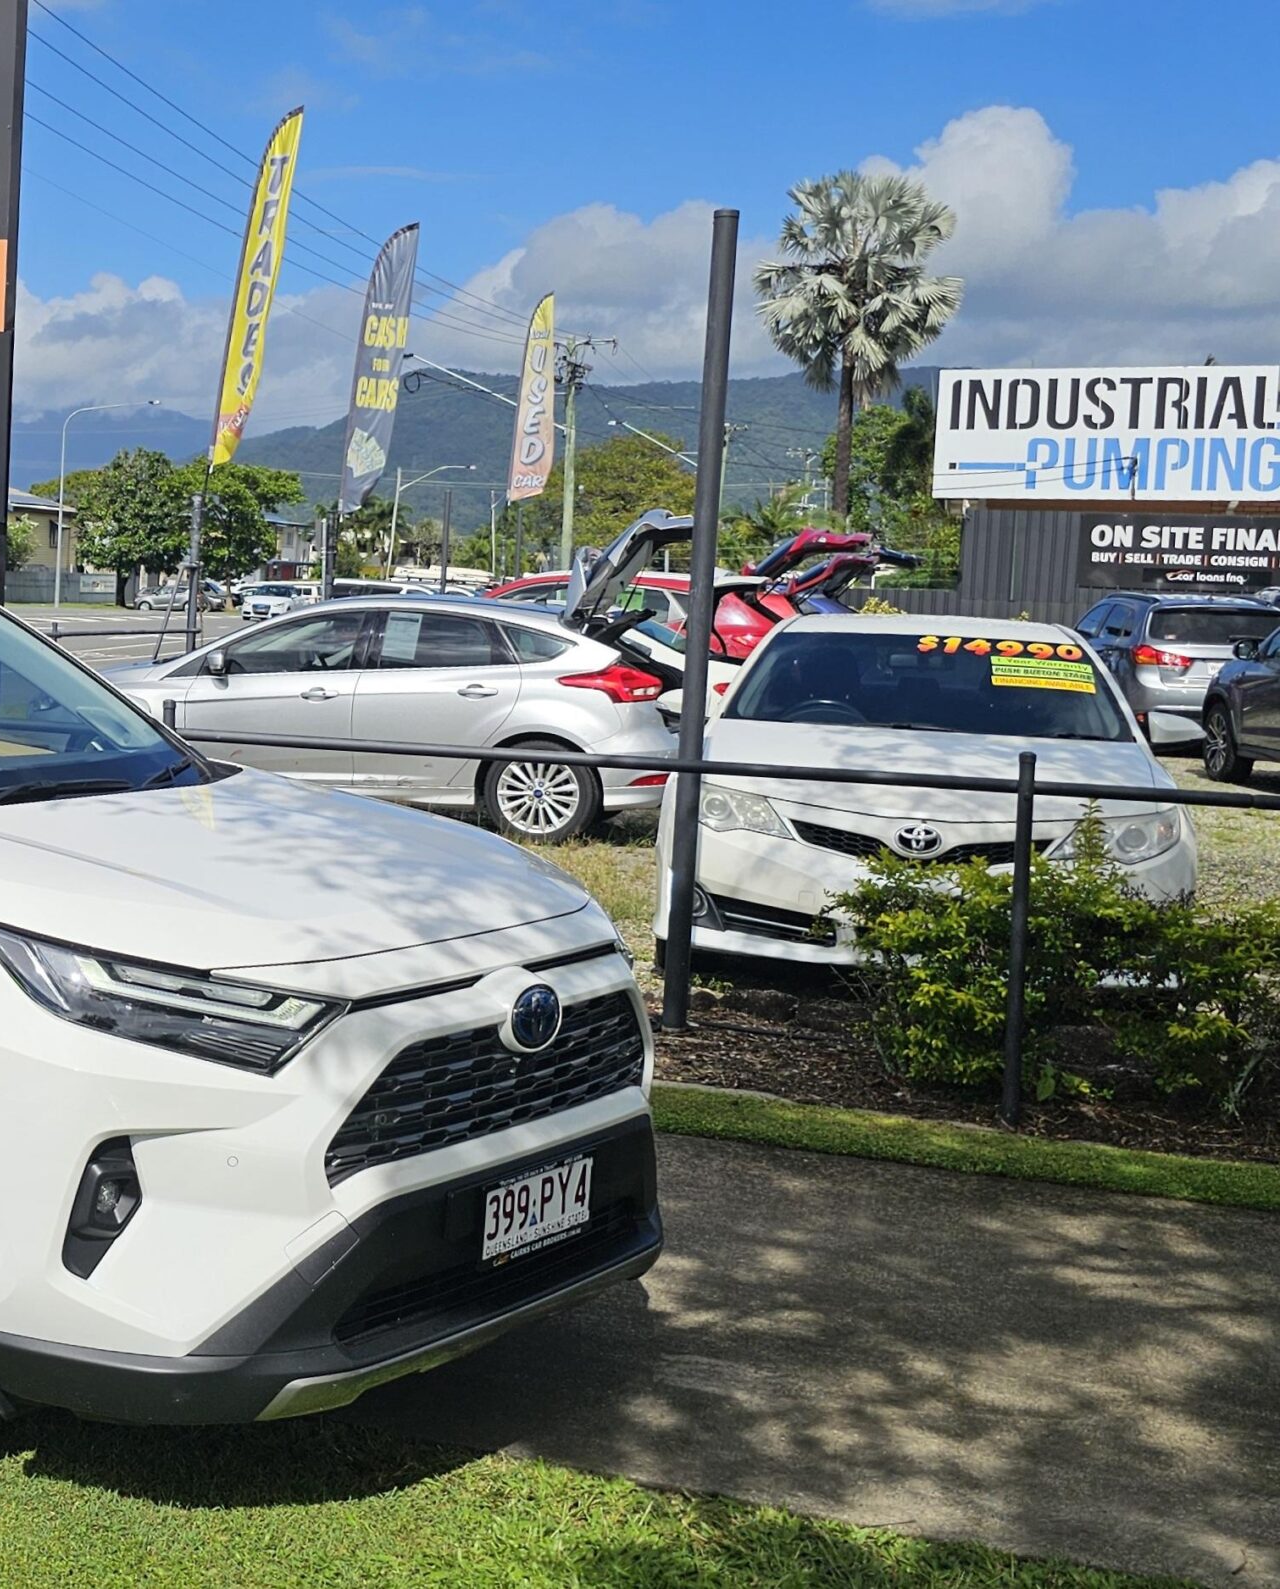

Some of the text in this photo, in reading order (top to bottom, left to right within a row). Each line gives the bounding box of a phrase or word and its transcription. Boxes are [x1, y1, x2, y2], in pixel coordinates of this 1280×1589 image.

[520, 344, 548, 465] USED
[949, 375, 1275, 431] INDUSTRIAL
[1024, 437, 1280, 493] PUMPING
[1090, 524, 1280, 551] ON SITE FINA
[1091, 551, 1118, 563] BUY
[1124, 552, 1154, 564] SELL
[1162, 553, 1202, 566] TRADE
[1210, 555, 1269, 568] CONSIGN
[1196, 572, 1225, 583] loans
[917, 635, 1084, 662] $14990
